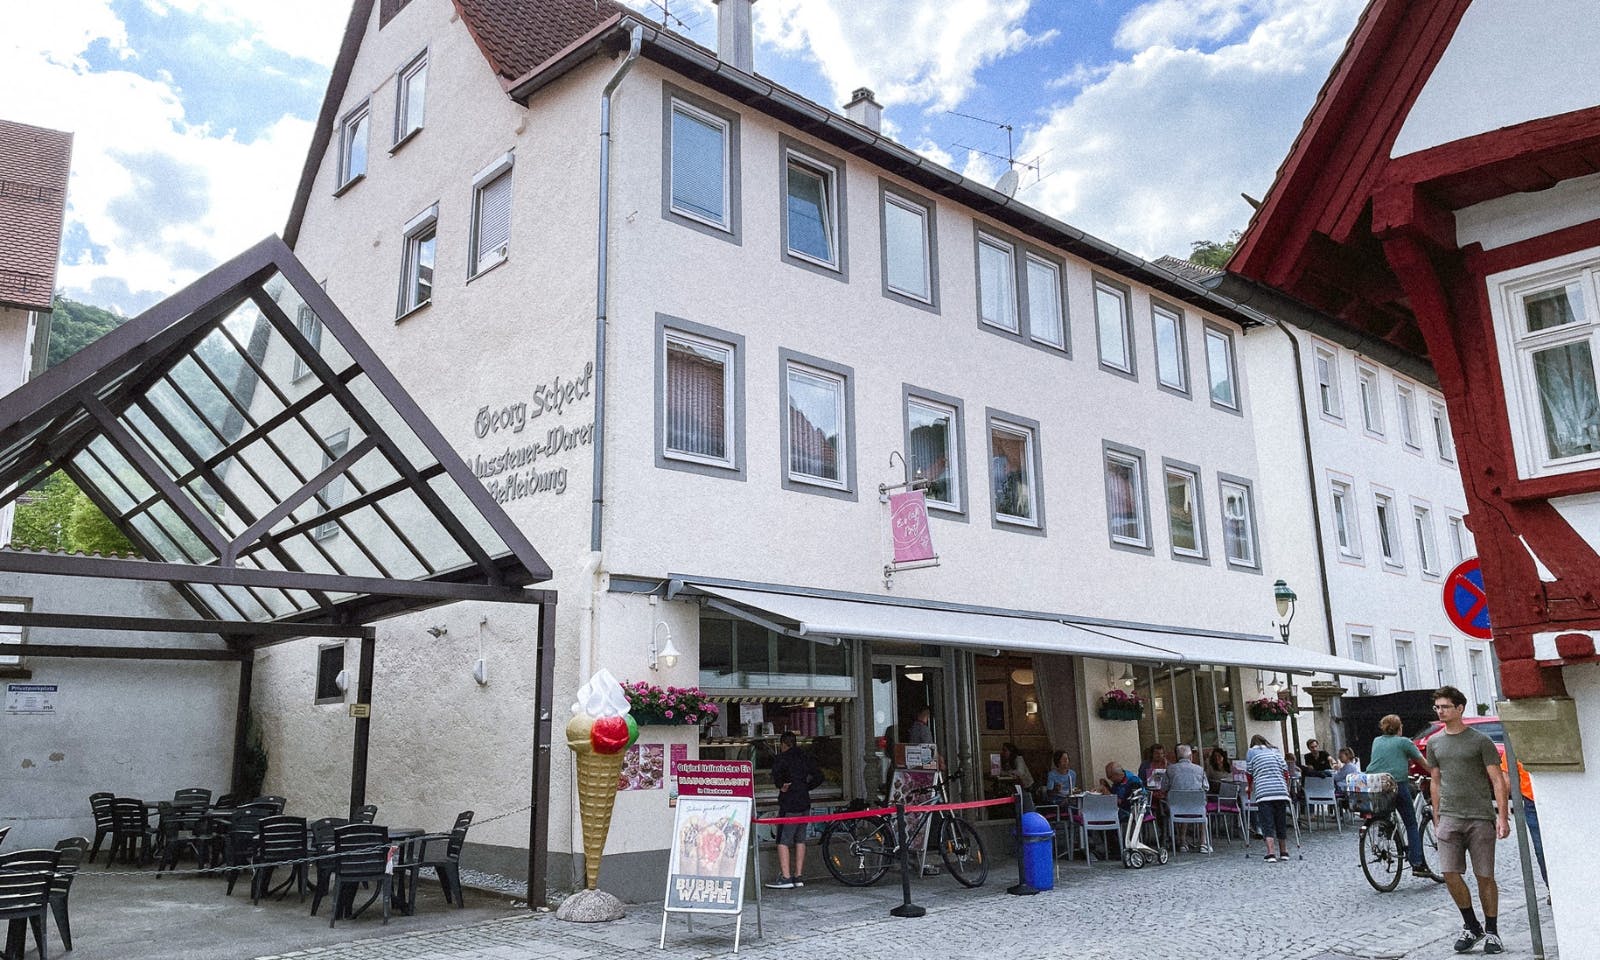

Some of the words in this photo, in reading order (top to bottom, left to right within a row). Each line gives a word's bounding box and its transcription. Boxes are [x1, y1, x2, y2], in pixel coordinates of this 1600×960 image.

[474, 402, 527, 439] Georg
[677, 763, 700, 773] Original
[740, 765, 751, 773] Eis
[676, 878, 732, 892] BUBBLE
[679, 889, 735, 904] WAFFEL
